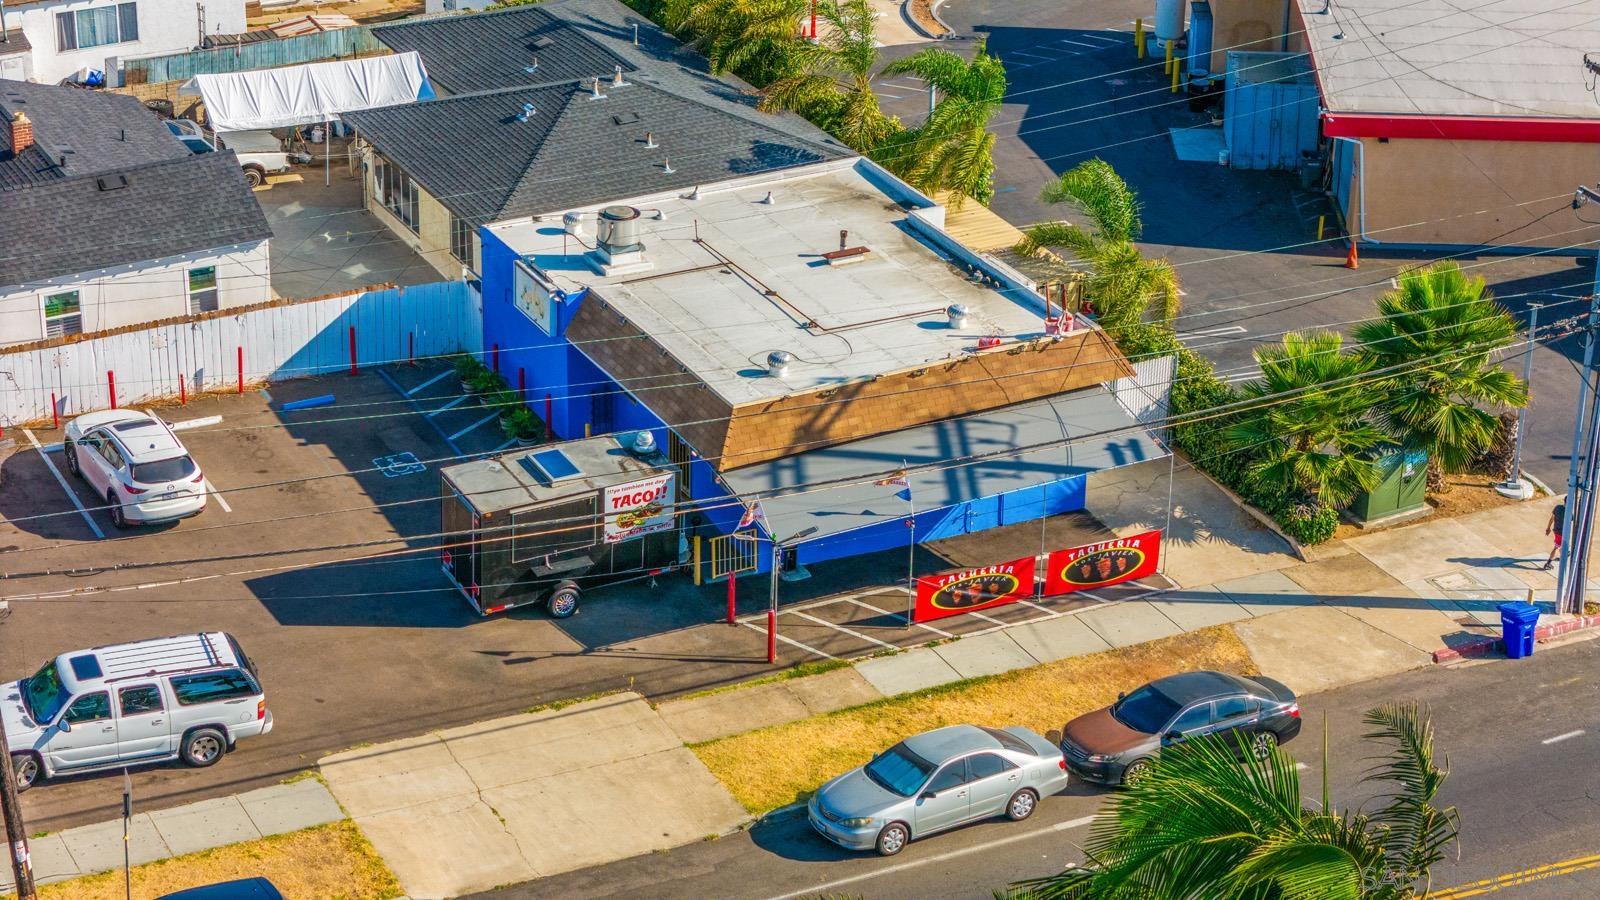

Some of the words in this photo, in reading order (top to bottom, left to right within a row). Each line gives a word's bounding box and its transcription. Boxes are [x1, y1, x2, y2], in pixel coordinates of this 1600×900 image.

[611, 485, 668, 509] TACO!!
[1068, 539, 1141, 561] TAQUERIA
[938, 565, 1014, 587] TAQUERIA
